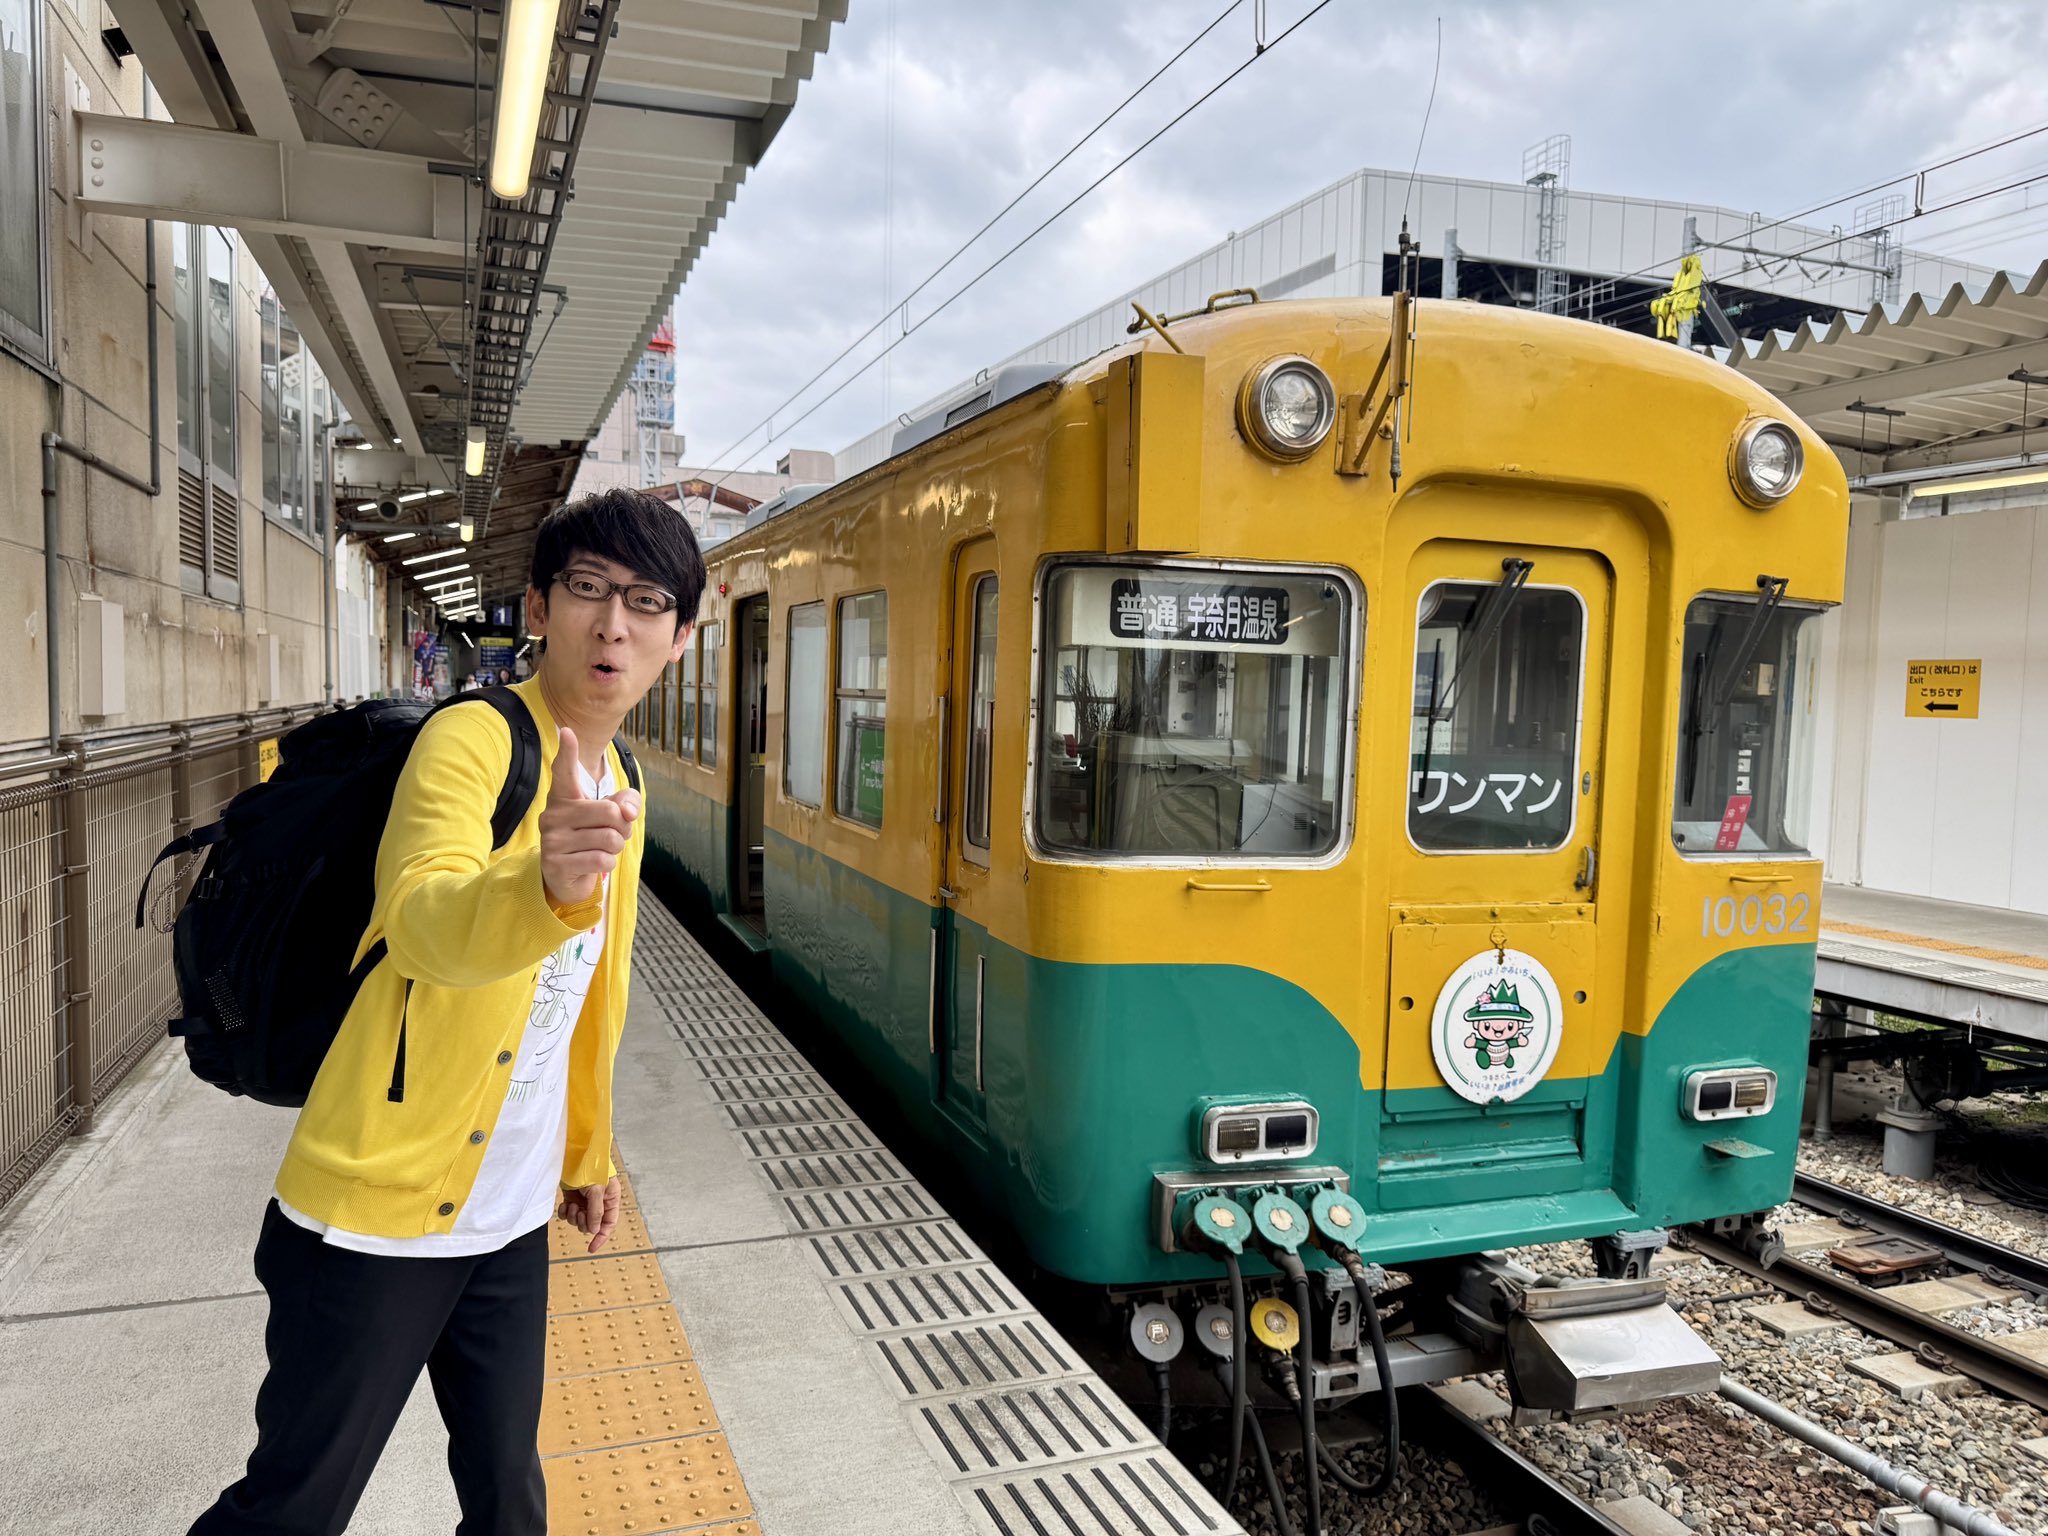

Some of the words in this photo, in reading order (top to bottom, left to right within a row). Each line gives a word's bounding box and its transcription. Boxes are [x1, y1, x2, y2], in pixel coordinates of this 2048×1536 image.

[498, 607, 505, 624] 1
[1116, 592, 1178, 633] 普通
[1187, 593, 1278, 641] 宇奈月温泉
[1909, 676, 1924, 684] Exit
[1920, 688, 1964, 697] こちらです
[1411, 770, 1562, 814] ワンマン
[1701, 891, 1811, 938] 10032
